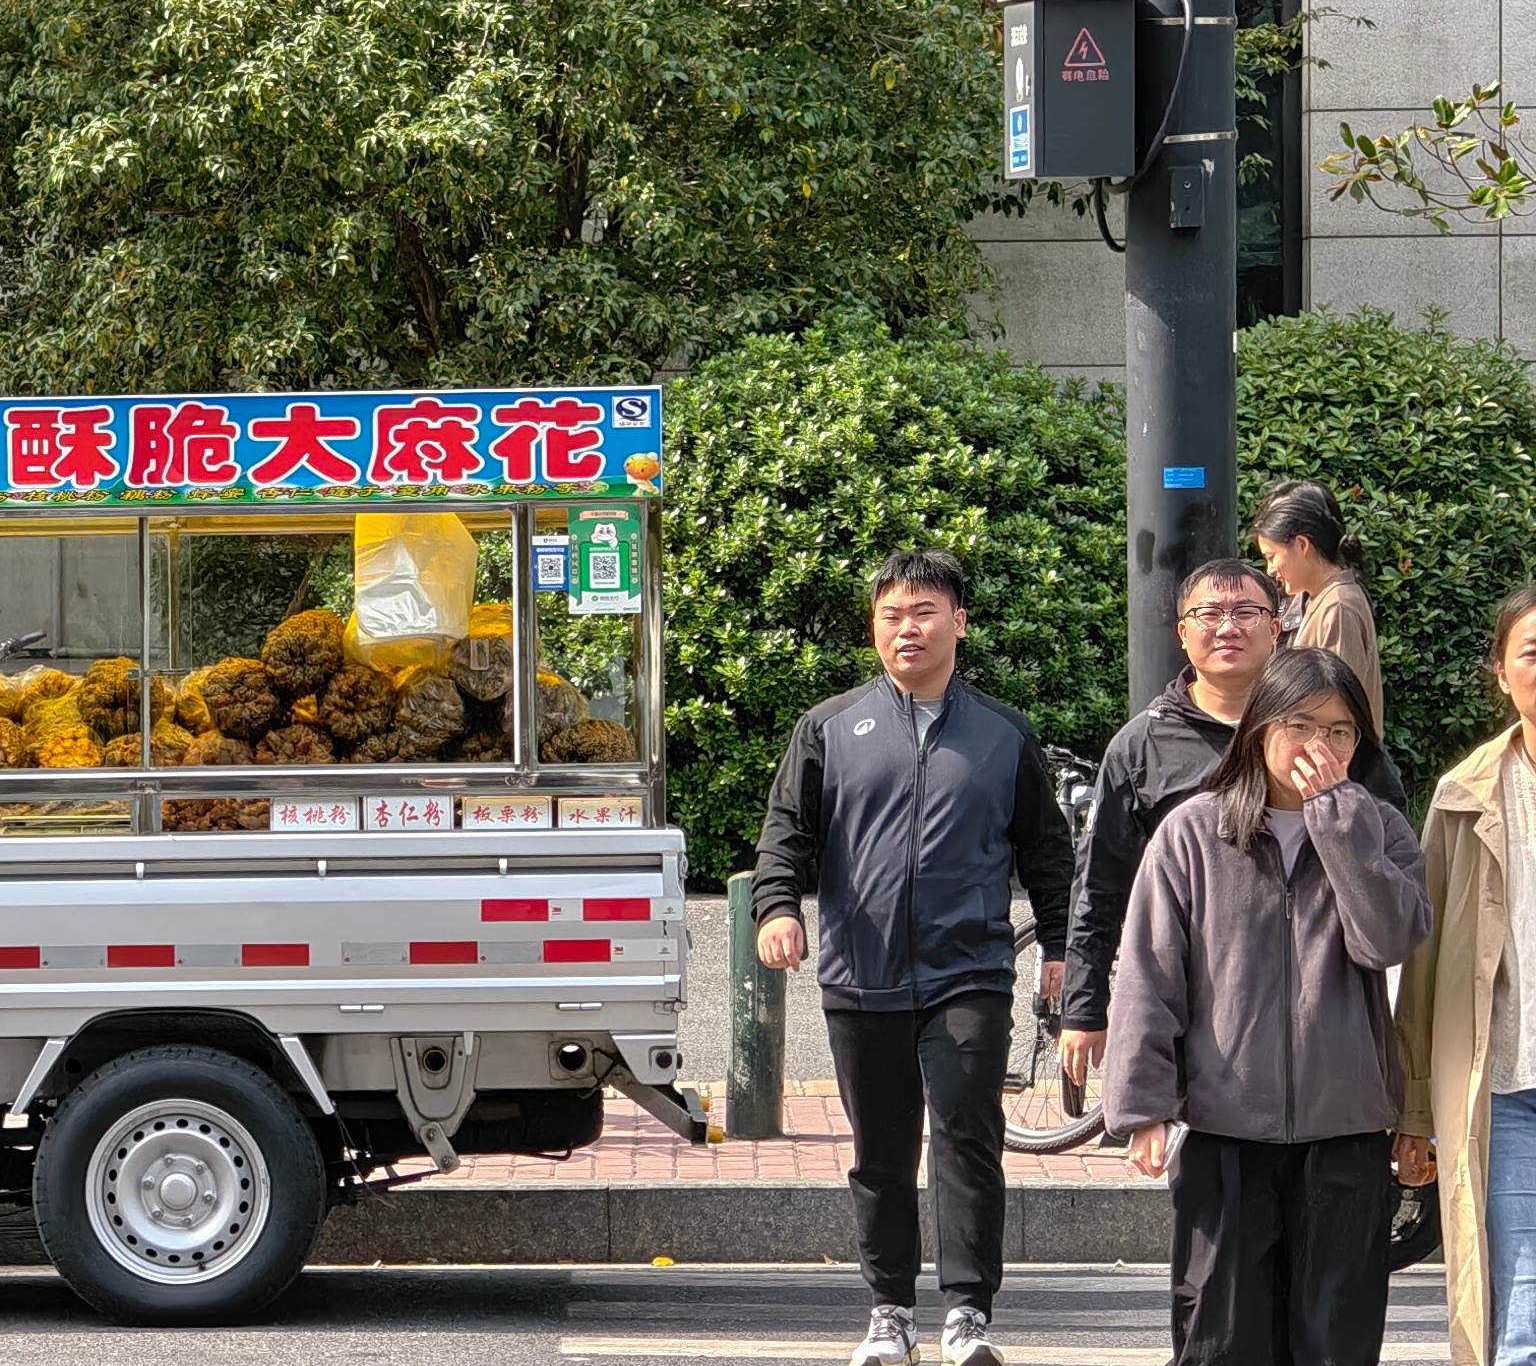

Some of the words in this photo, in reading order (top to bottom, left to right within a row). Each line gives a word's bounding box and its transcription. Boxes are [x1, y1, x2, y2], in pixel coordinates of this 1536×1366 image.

[278, 804, 351, 826] 核桃粉
[373, 799, 445, 828] 杏仁粉
[472, 804, 543, 825] 板栗粉
[568, 806, 635, 825] 水果汁
